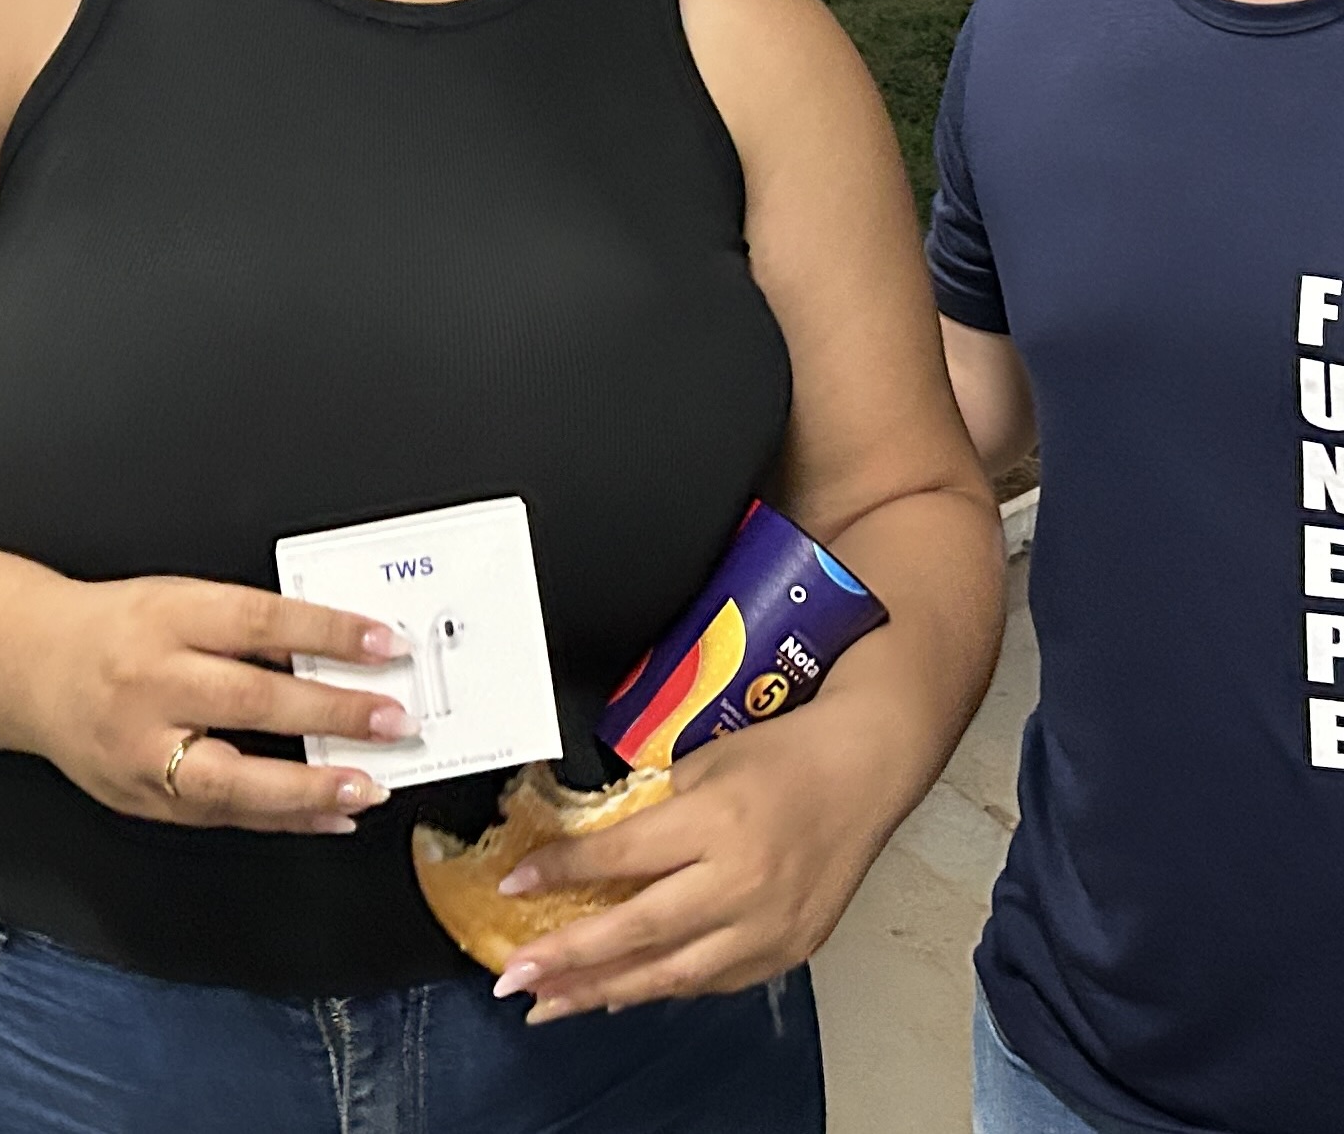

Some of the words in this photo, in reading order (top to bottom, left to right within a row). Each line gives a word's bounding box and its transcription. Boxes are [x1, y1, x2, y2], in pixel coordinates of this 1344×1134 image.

[379, 556, 434, 582] TWS
[779, 635, 820, 679] Nota
[751, 678, 786, 712] 5
